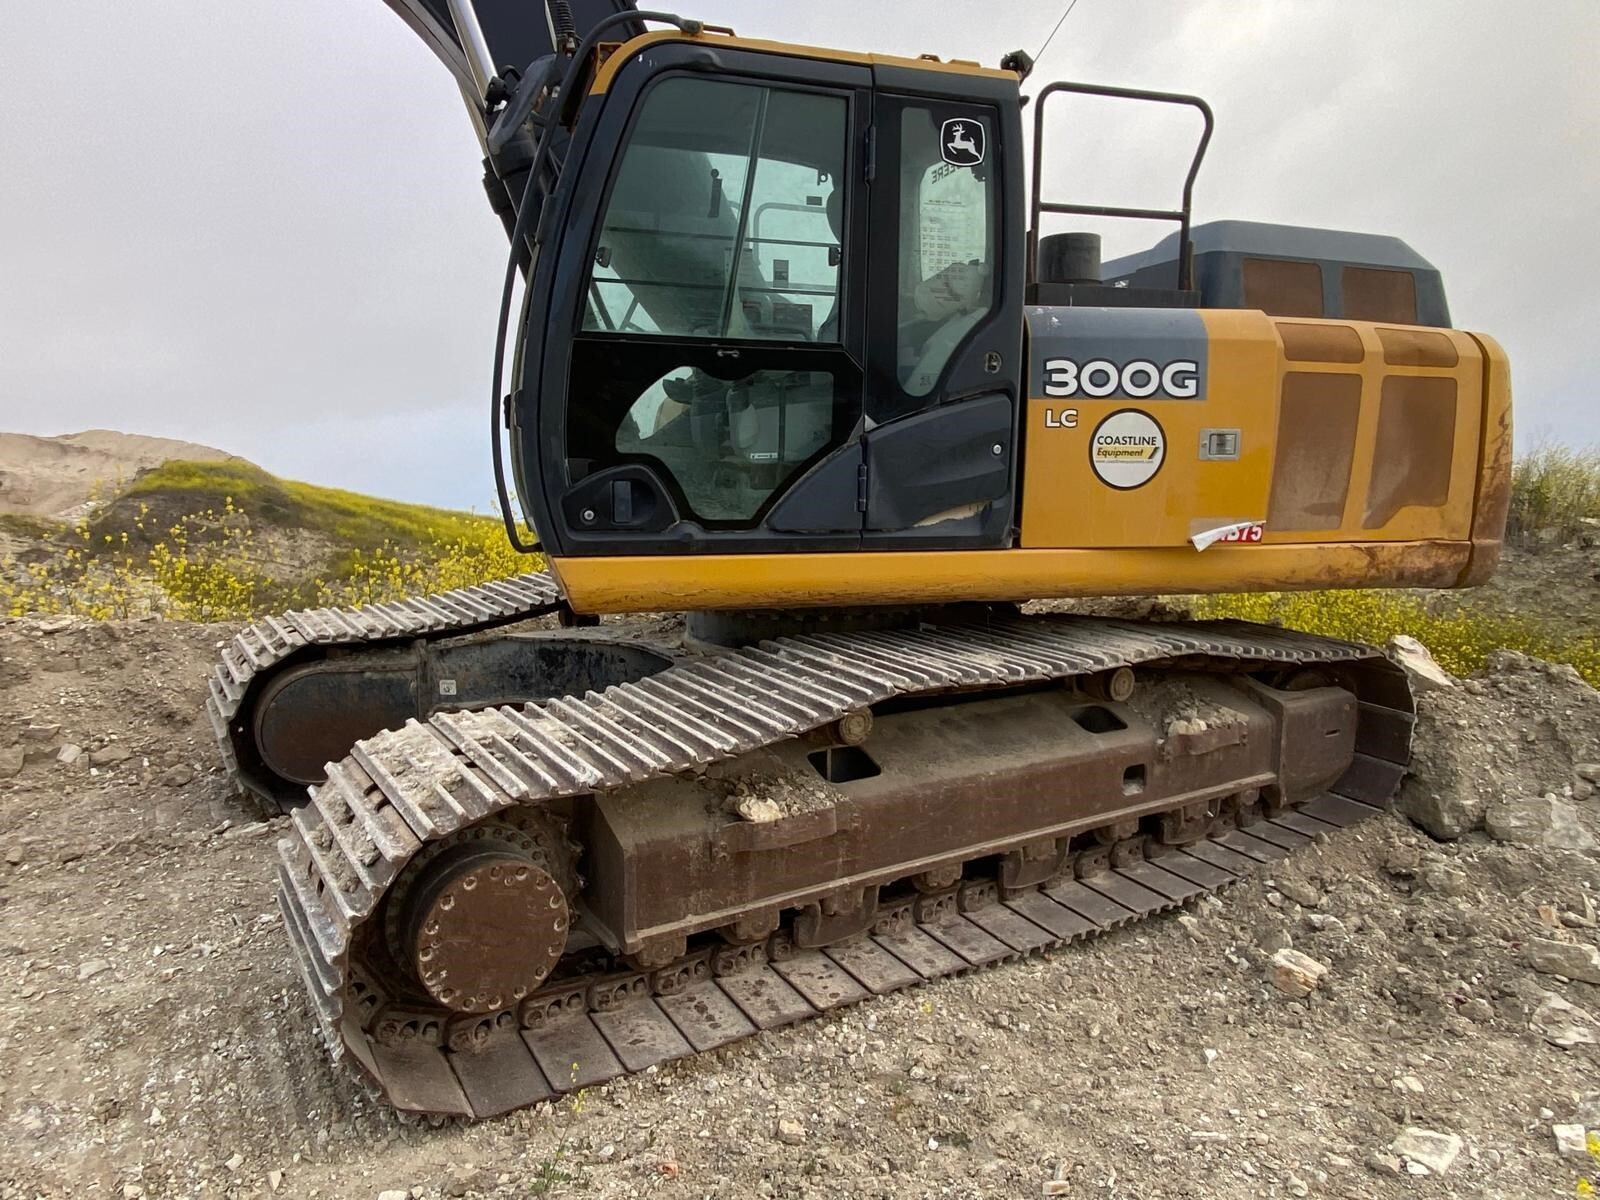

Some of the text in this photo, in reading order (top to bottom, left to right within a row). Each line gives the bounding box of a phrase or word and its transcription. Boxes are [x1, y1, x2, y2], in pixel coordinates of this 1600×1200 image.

[1044, 358, 1198, 398] 300G
[1045, 409, 1078, 428] LC
[1097, 435, 1157, 446] COASTLINE
[1097, 447, 1143, 458] Equipment
